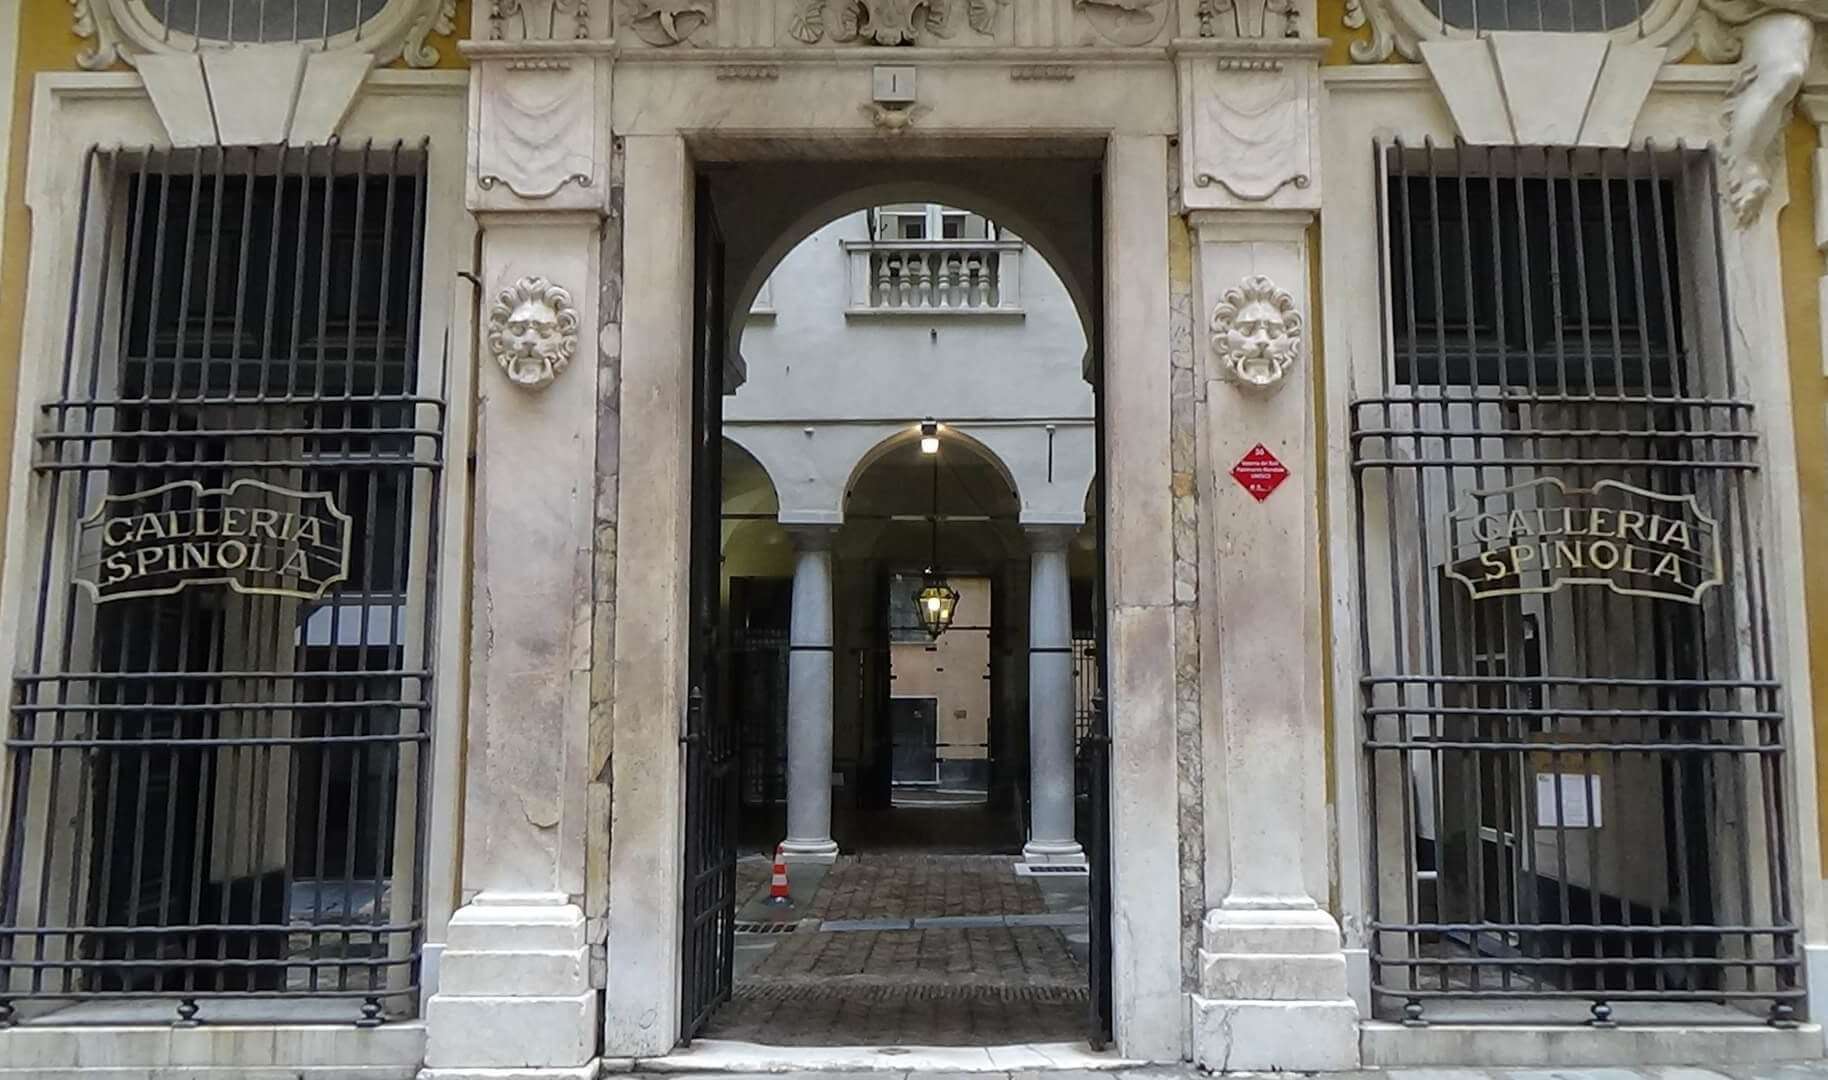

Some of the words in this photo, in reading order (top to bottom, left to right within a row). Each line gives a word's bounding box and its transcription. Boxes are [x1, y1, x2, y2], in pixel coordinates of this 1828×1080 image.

[104, 507, 323, 547] GALLERIA
[1472, 507, 1693, 550] GALLERIA
[106, 540, 311, 583] SPINOLA
[1480, 540, 1683, 583] SPINOLA
